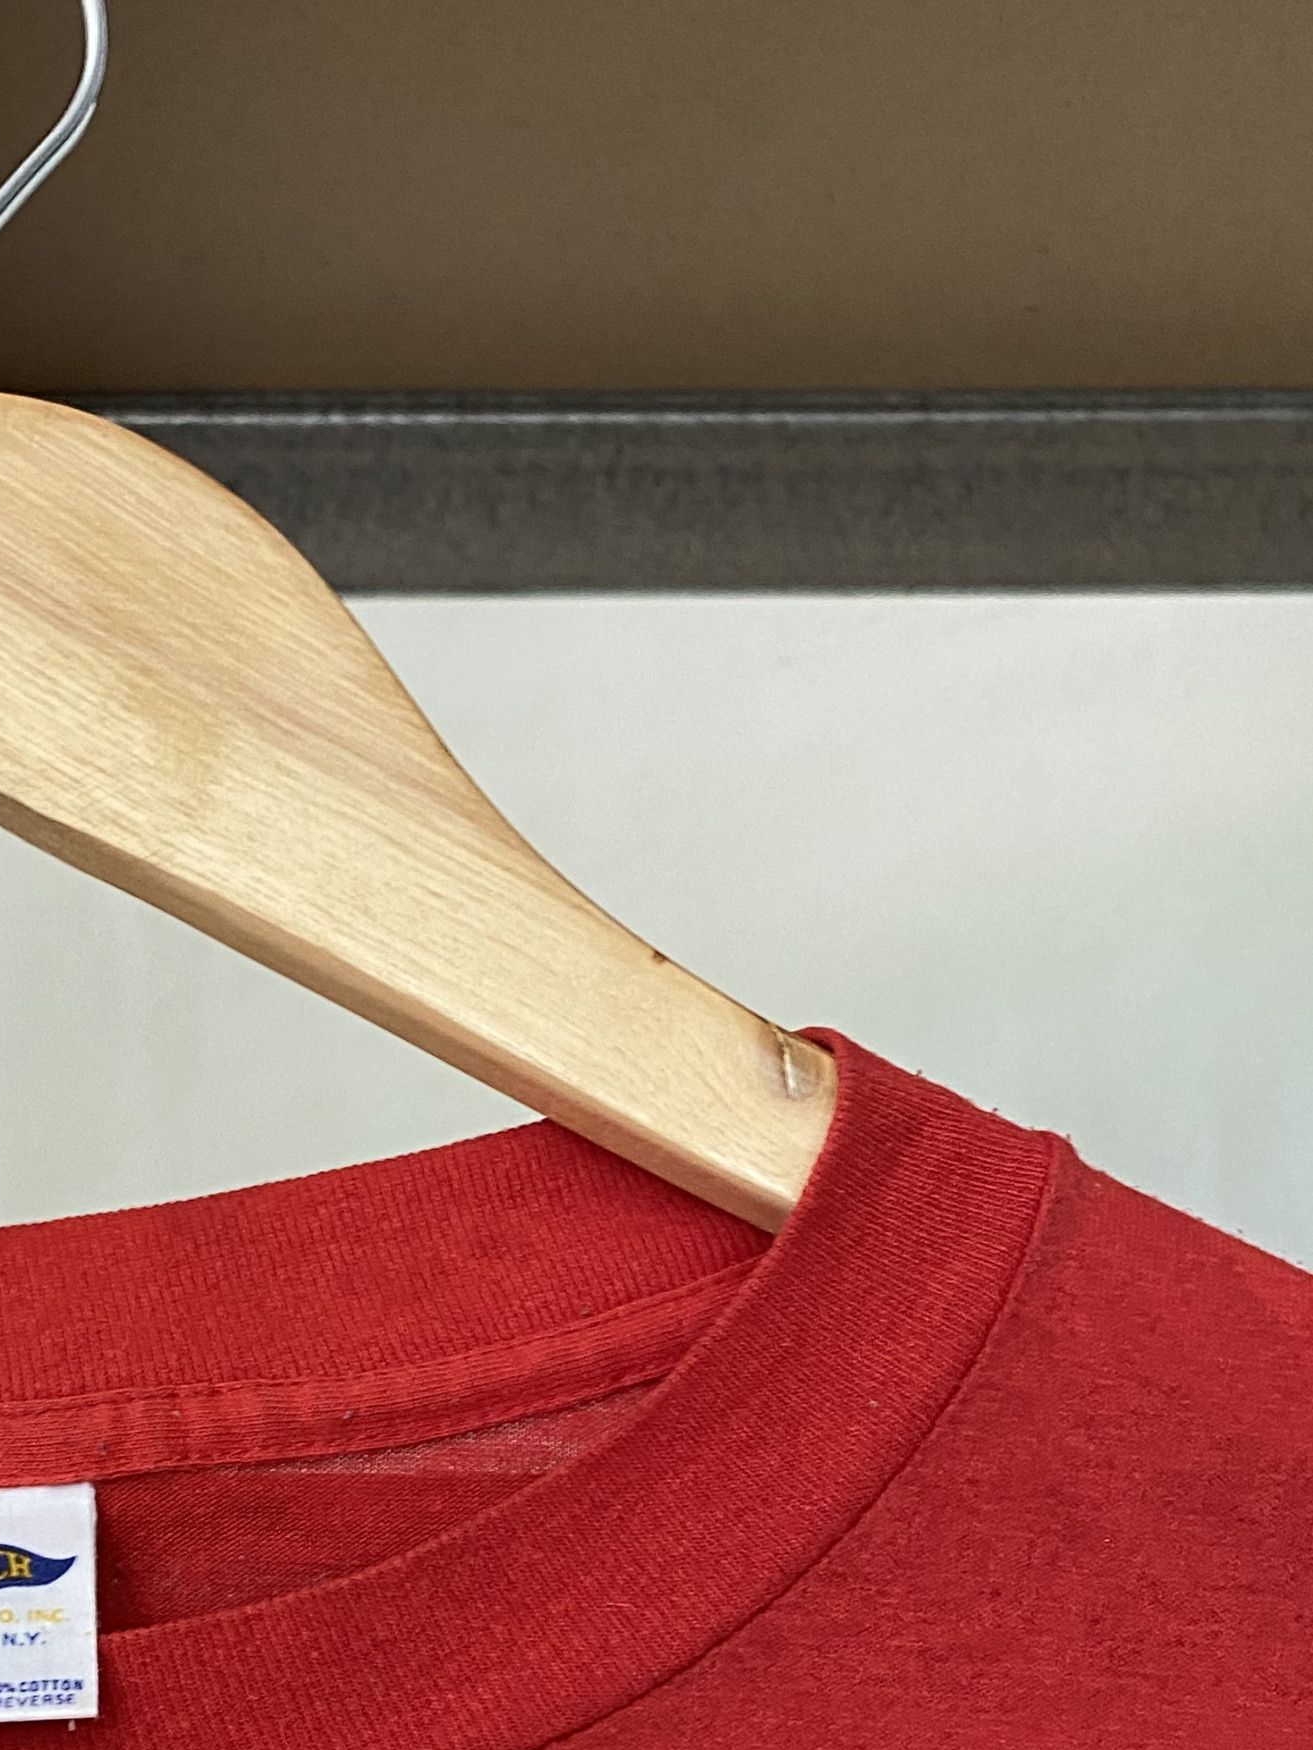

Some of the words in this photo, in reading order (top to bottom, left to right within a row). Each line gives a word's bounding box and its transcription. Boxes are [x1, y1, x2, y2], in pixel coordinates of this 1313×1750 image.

[28, 1607, 70, 1623] INC.
[3, 1631, 47, 1646] N.Y.
[19, 1679, 85, 1693] COTTON
